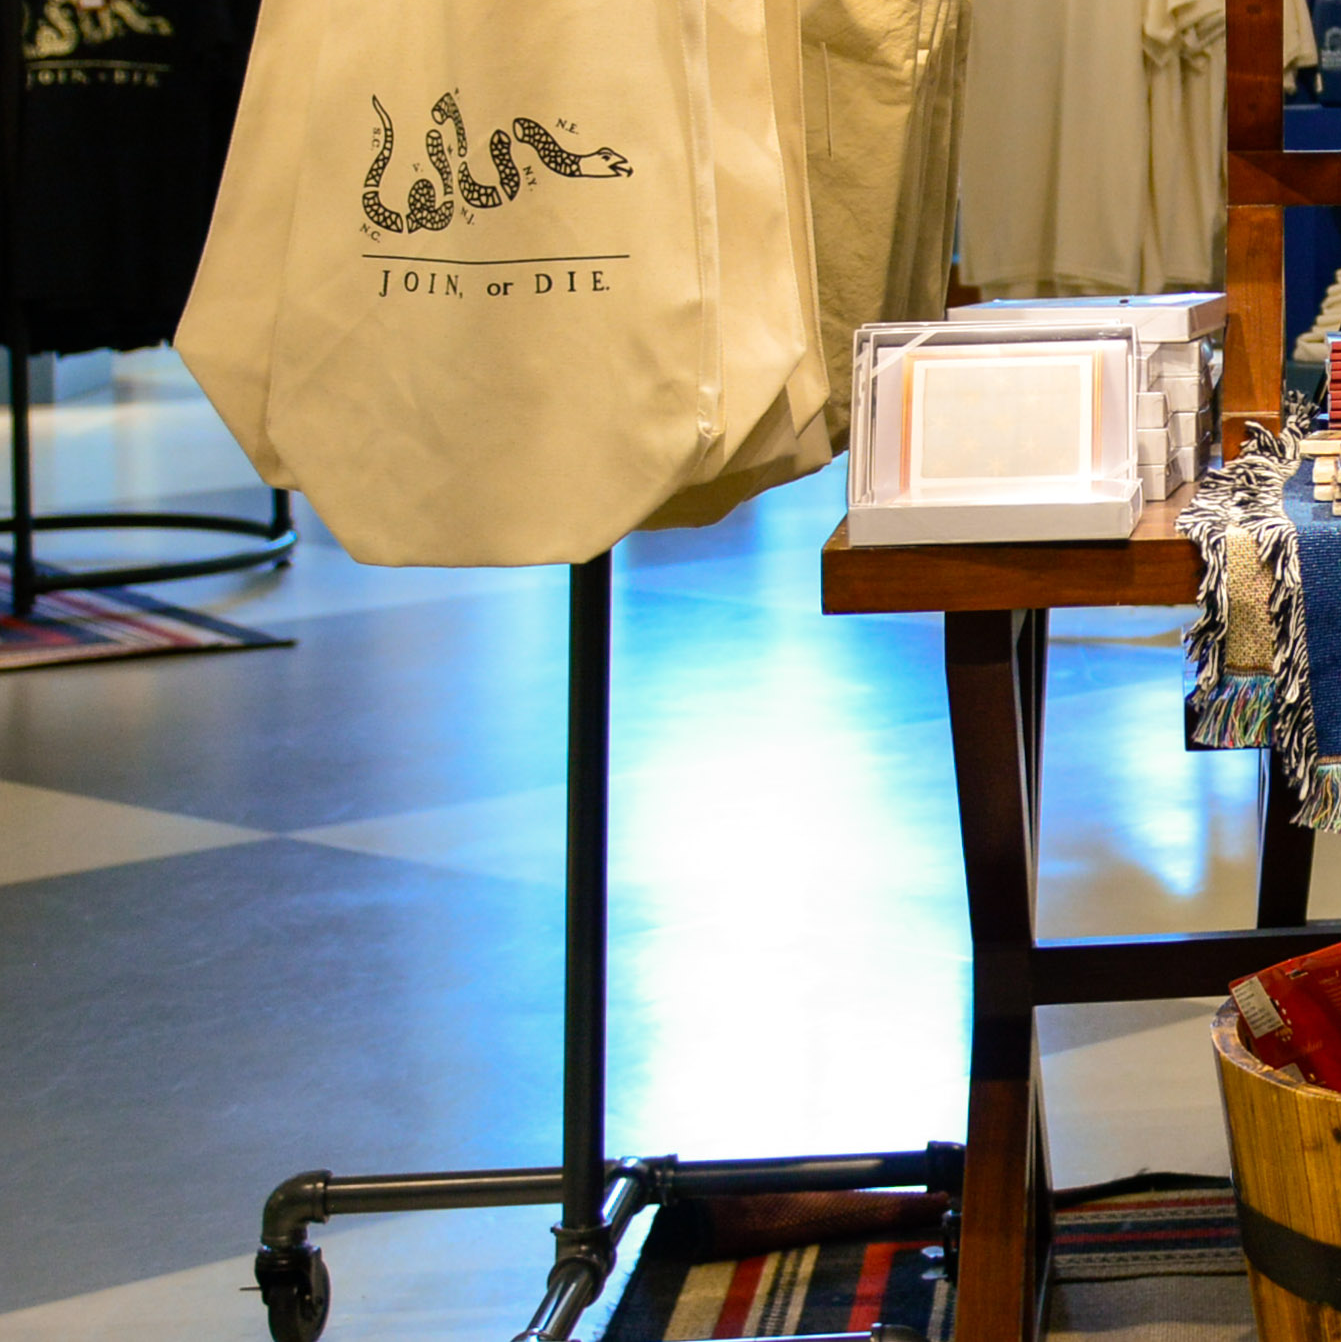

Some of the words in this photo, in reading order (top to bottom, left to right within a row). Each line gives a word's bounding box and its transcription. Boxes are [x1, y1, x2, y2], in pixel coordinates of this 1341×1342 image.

[555, 118, 580, 135] N.E.
[522, 165, 535, 191] N.Y.
[359, 223, 381, 243] N.C.
[379, 269, 464, 298] JOIN,
[486, 280, 514, 296] or
[534, 270, 611, 295] DIE.
